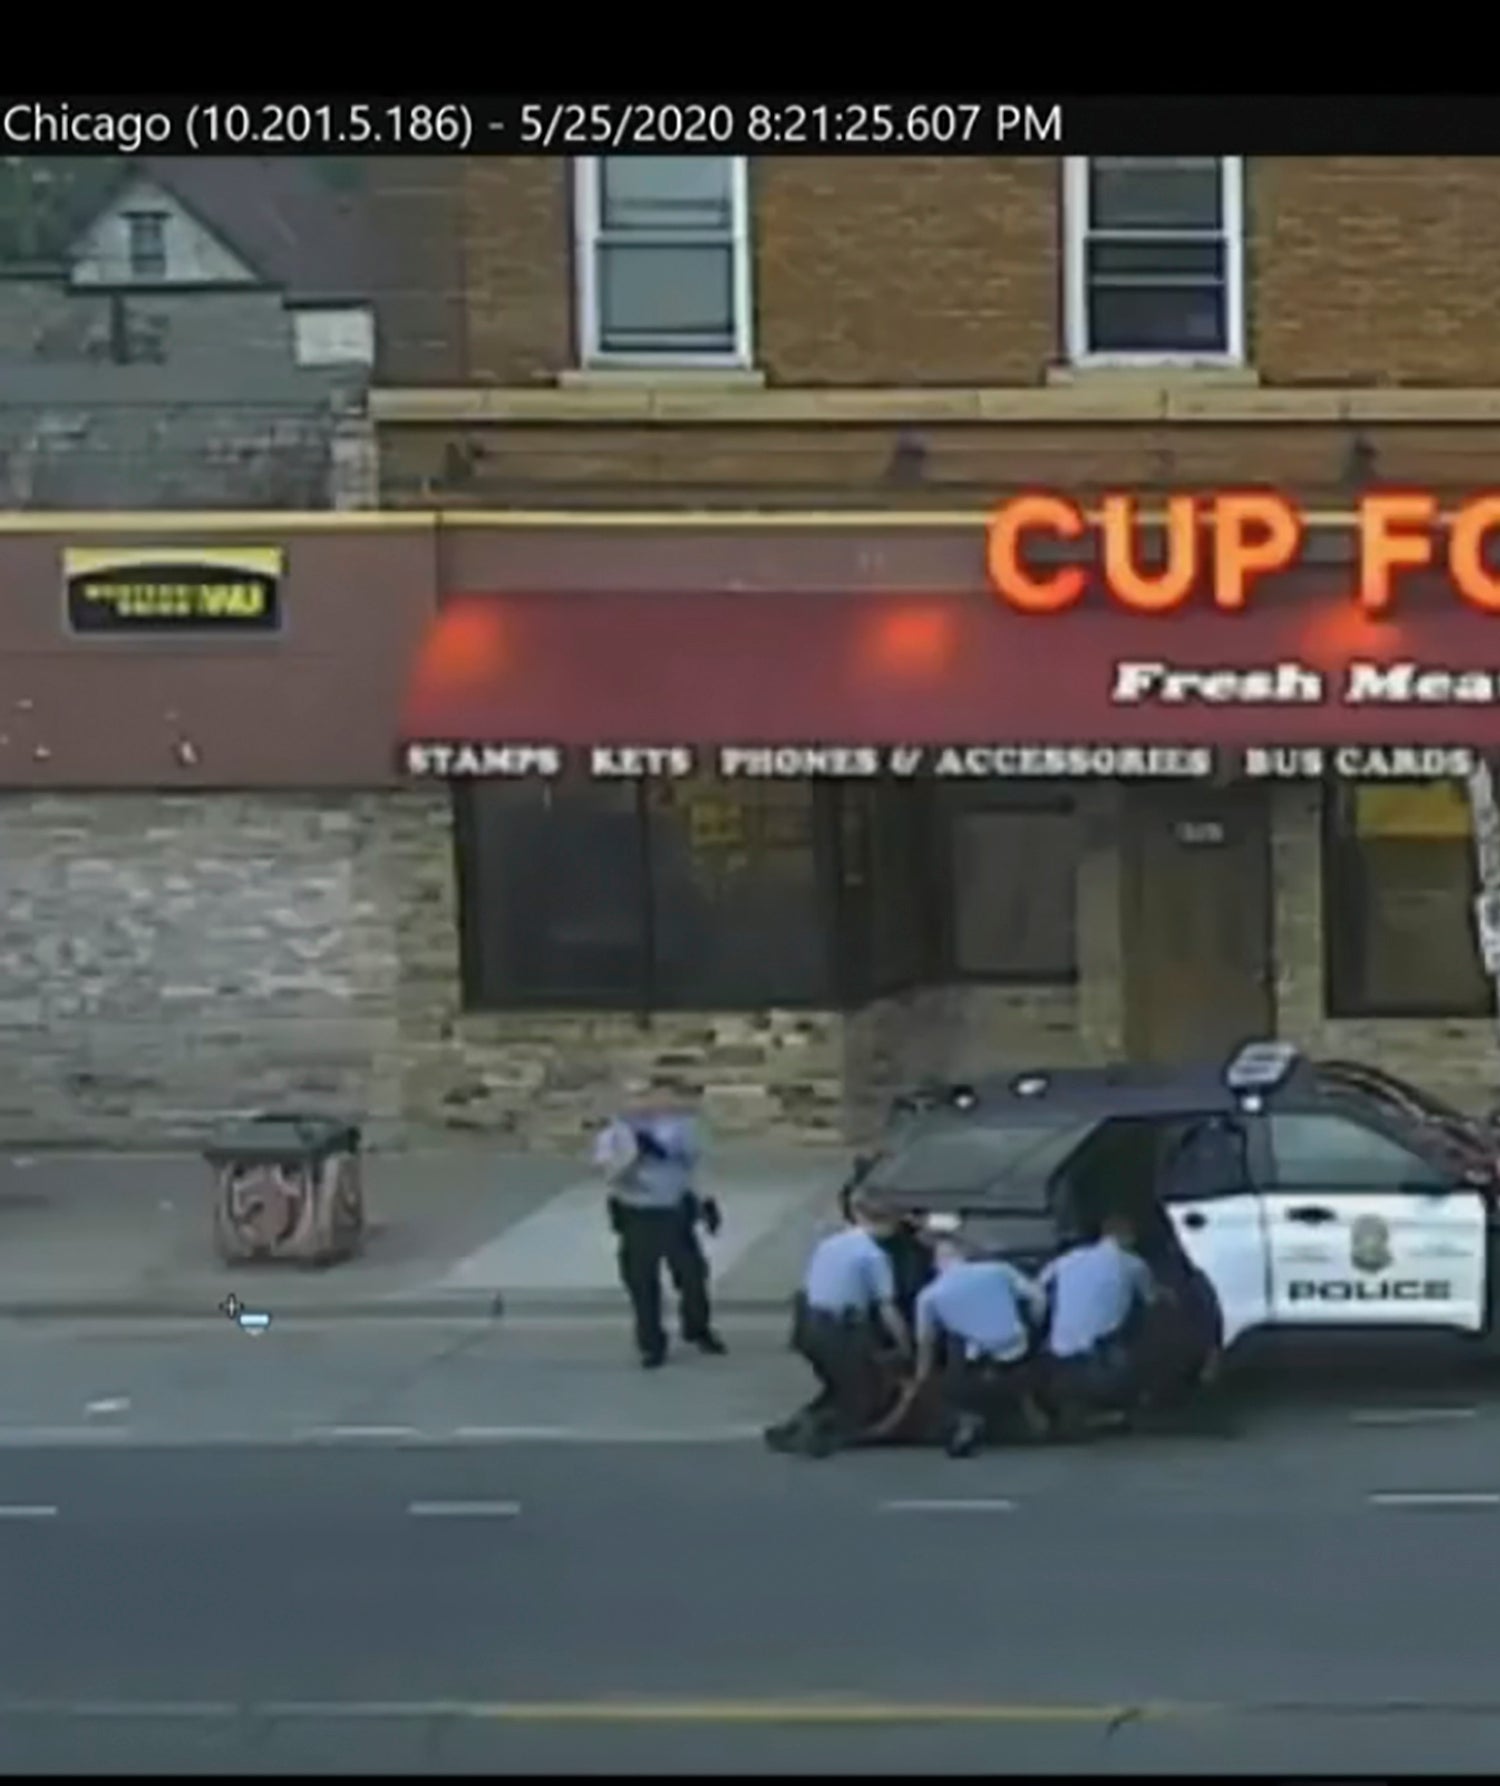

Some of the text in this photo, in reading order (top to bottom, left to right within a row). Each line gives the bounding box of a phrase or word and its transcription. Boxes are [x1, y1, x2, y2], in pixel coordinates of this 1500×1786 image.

[986, 494, 1304, 611] CUP
[1114, 662, 1321, 701] Fresh
[408, 746, 559, 775] STAMPS
[721, 748, 878, 775] PHONES
[935, 747, 1210, 775] ACCESSORIES
[1246, 748, 1323, 775] BUS
[1335, 748, 1472, 775] CARDS
[1288, 1279, 1452, 1301] POLICE
